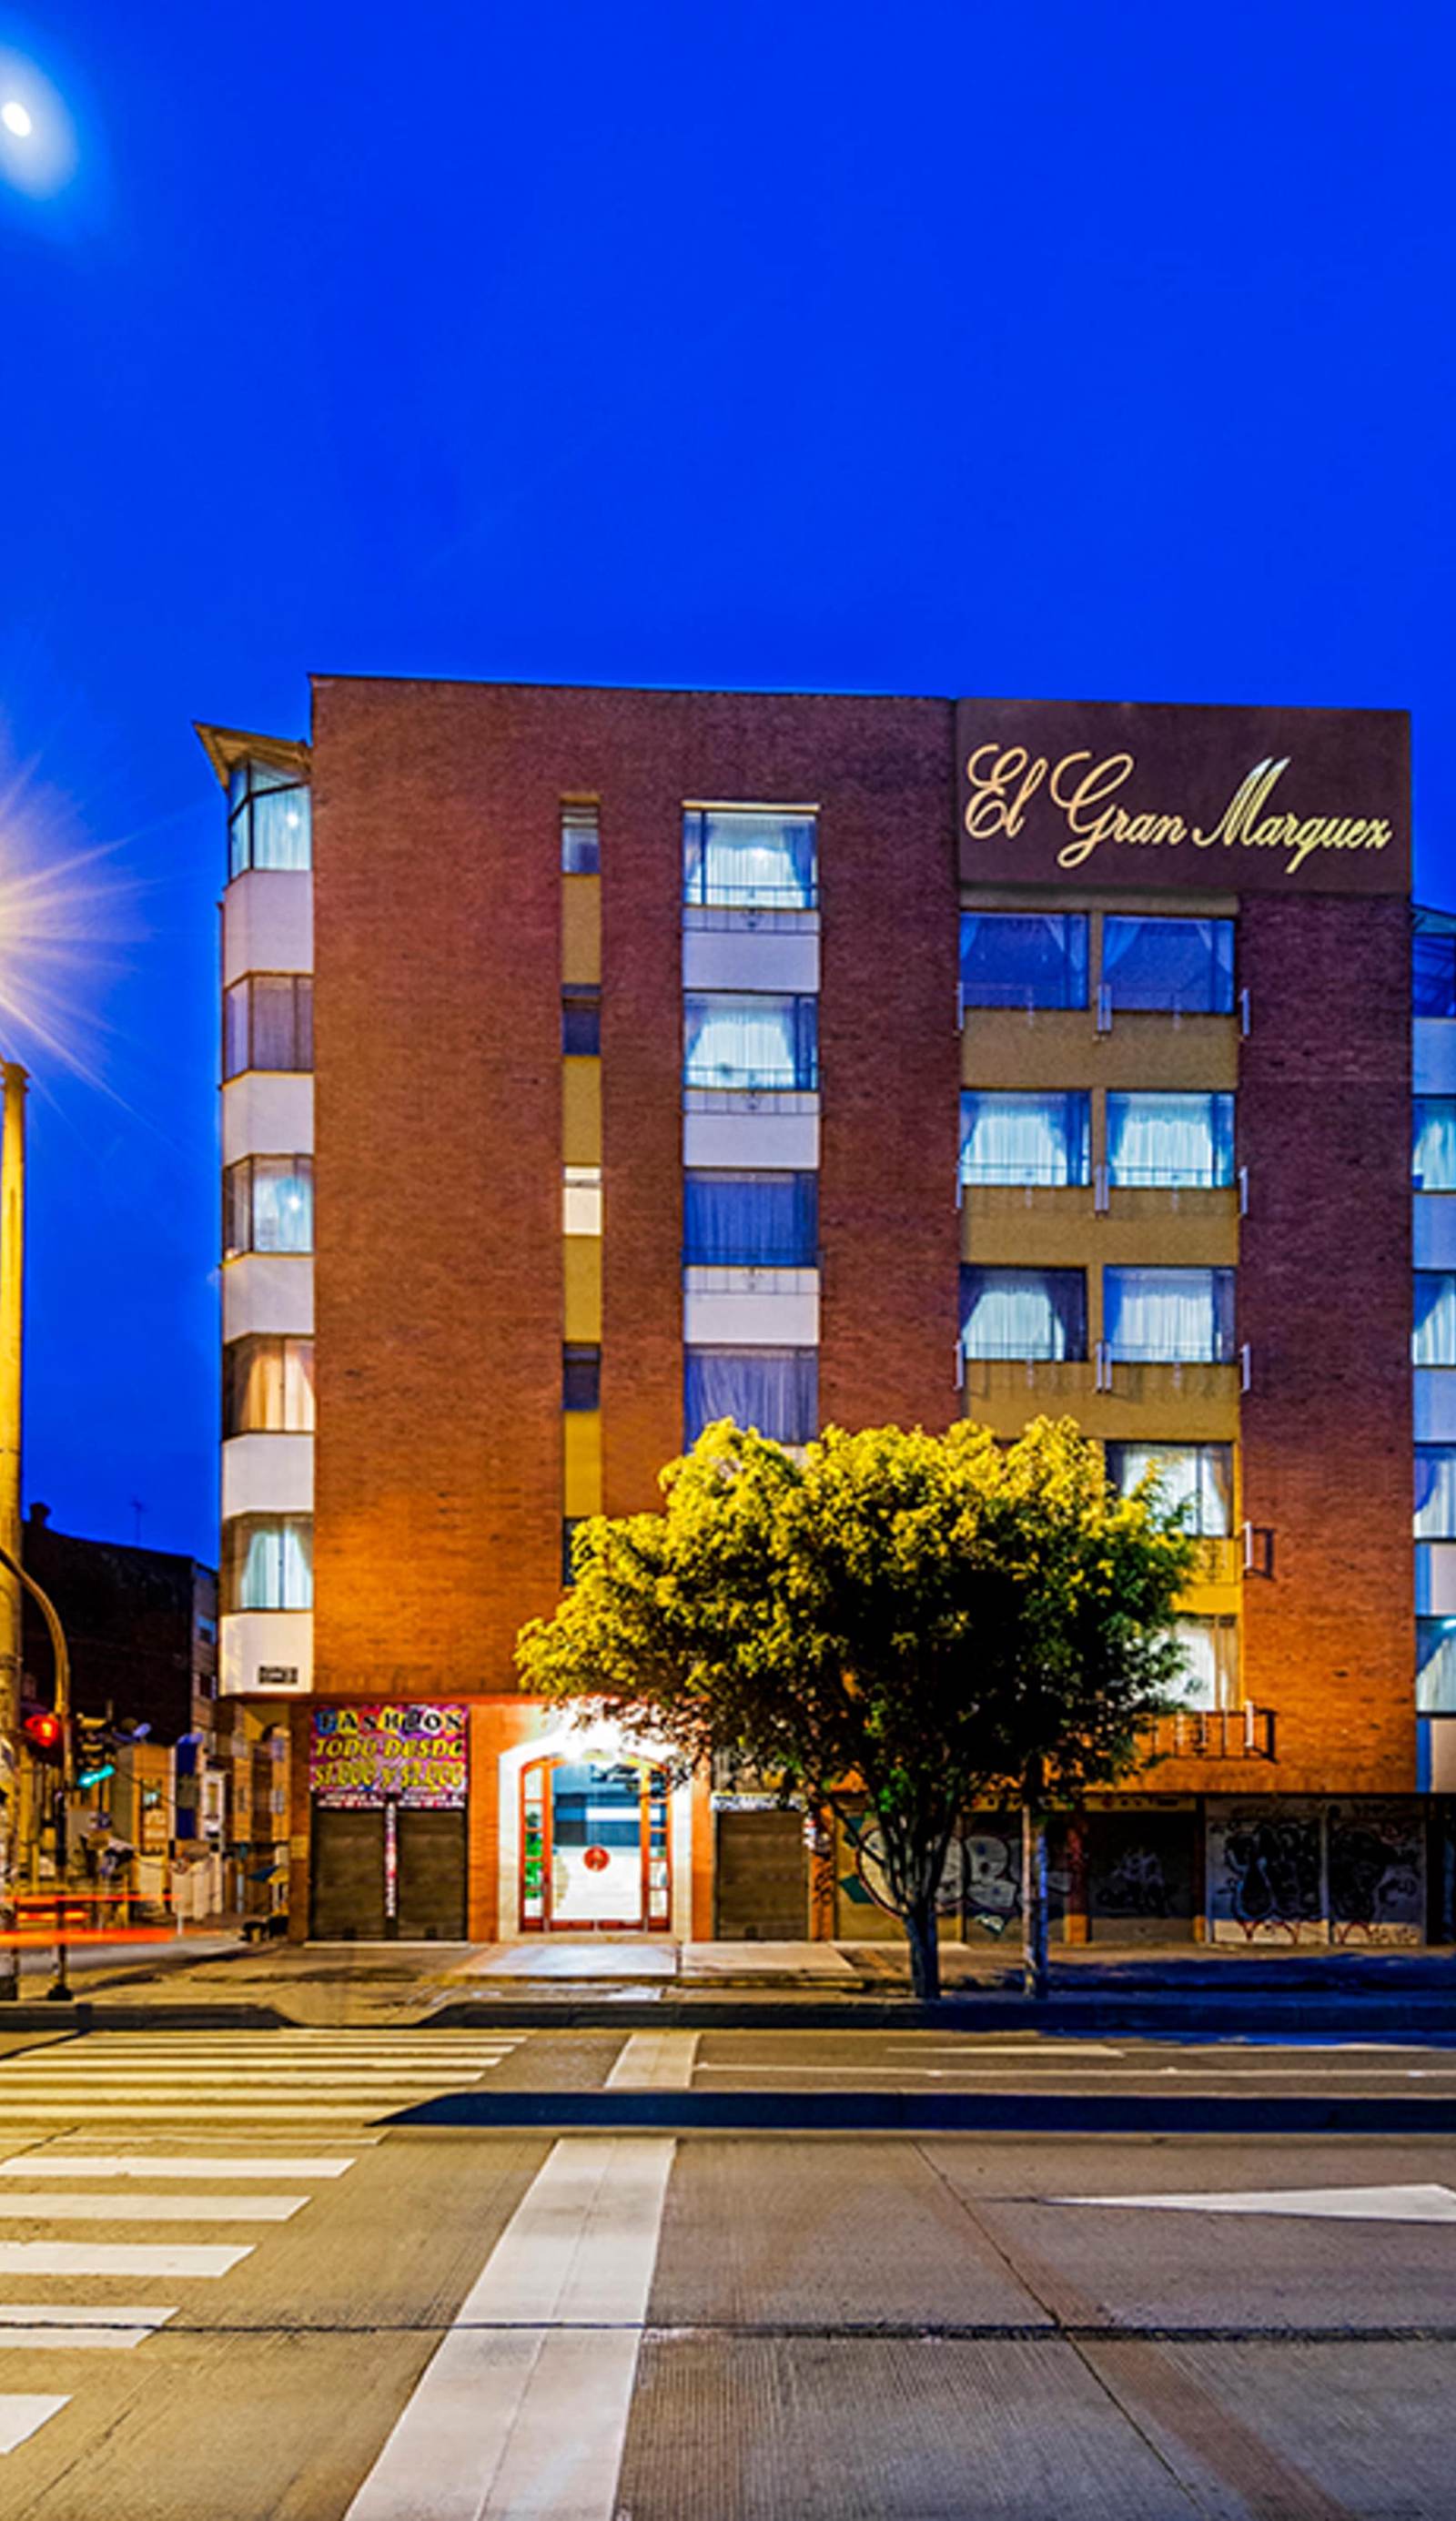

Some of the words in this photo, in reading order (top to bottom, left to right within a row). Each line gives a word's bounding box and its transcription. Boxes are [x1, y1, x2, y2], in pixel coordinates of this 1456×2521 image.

[965, 743, 1048, 839] El
[1049, 750, 1187, 868] Gran
[316, 1738, 378, 1758] TODO
